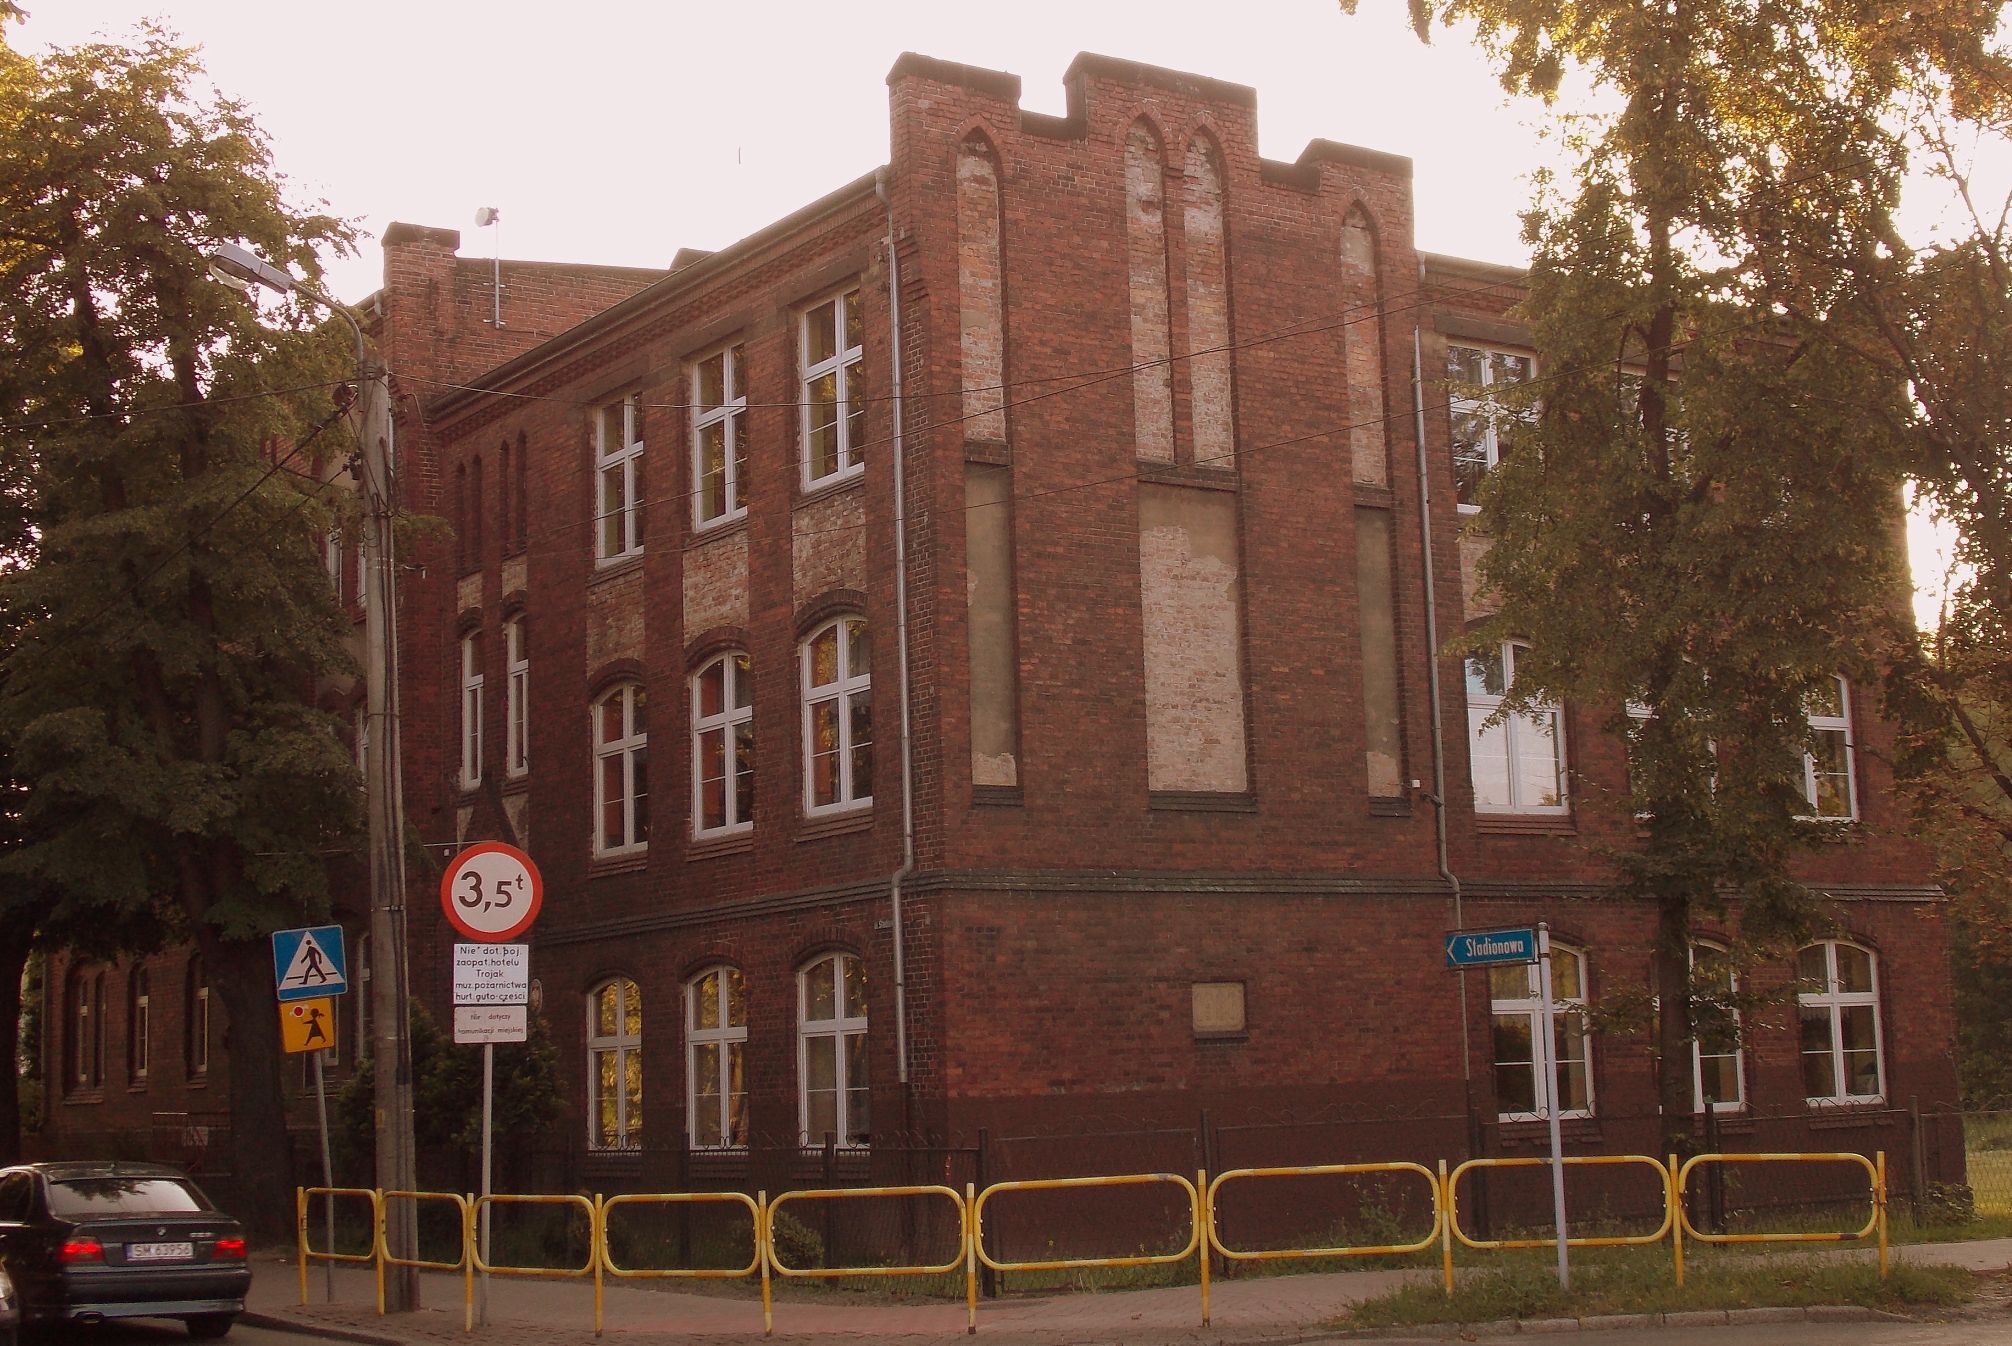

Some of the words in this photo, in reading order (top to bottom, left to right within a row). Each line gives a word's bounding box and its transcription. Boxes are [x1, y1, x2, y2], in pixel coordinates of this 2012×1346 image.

[460, 946, 476, 955] Nie
[1466, 937, 1524, 957] Stadionowa
[476, 969, 504, 980] Trojak
[488, 1013, 511, 1021] dotyczy
[497, 1026, 524, 1035] miejskiej
